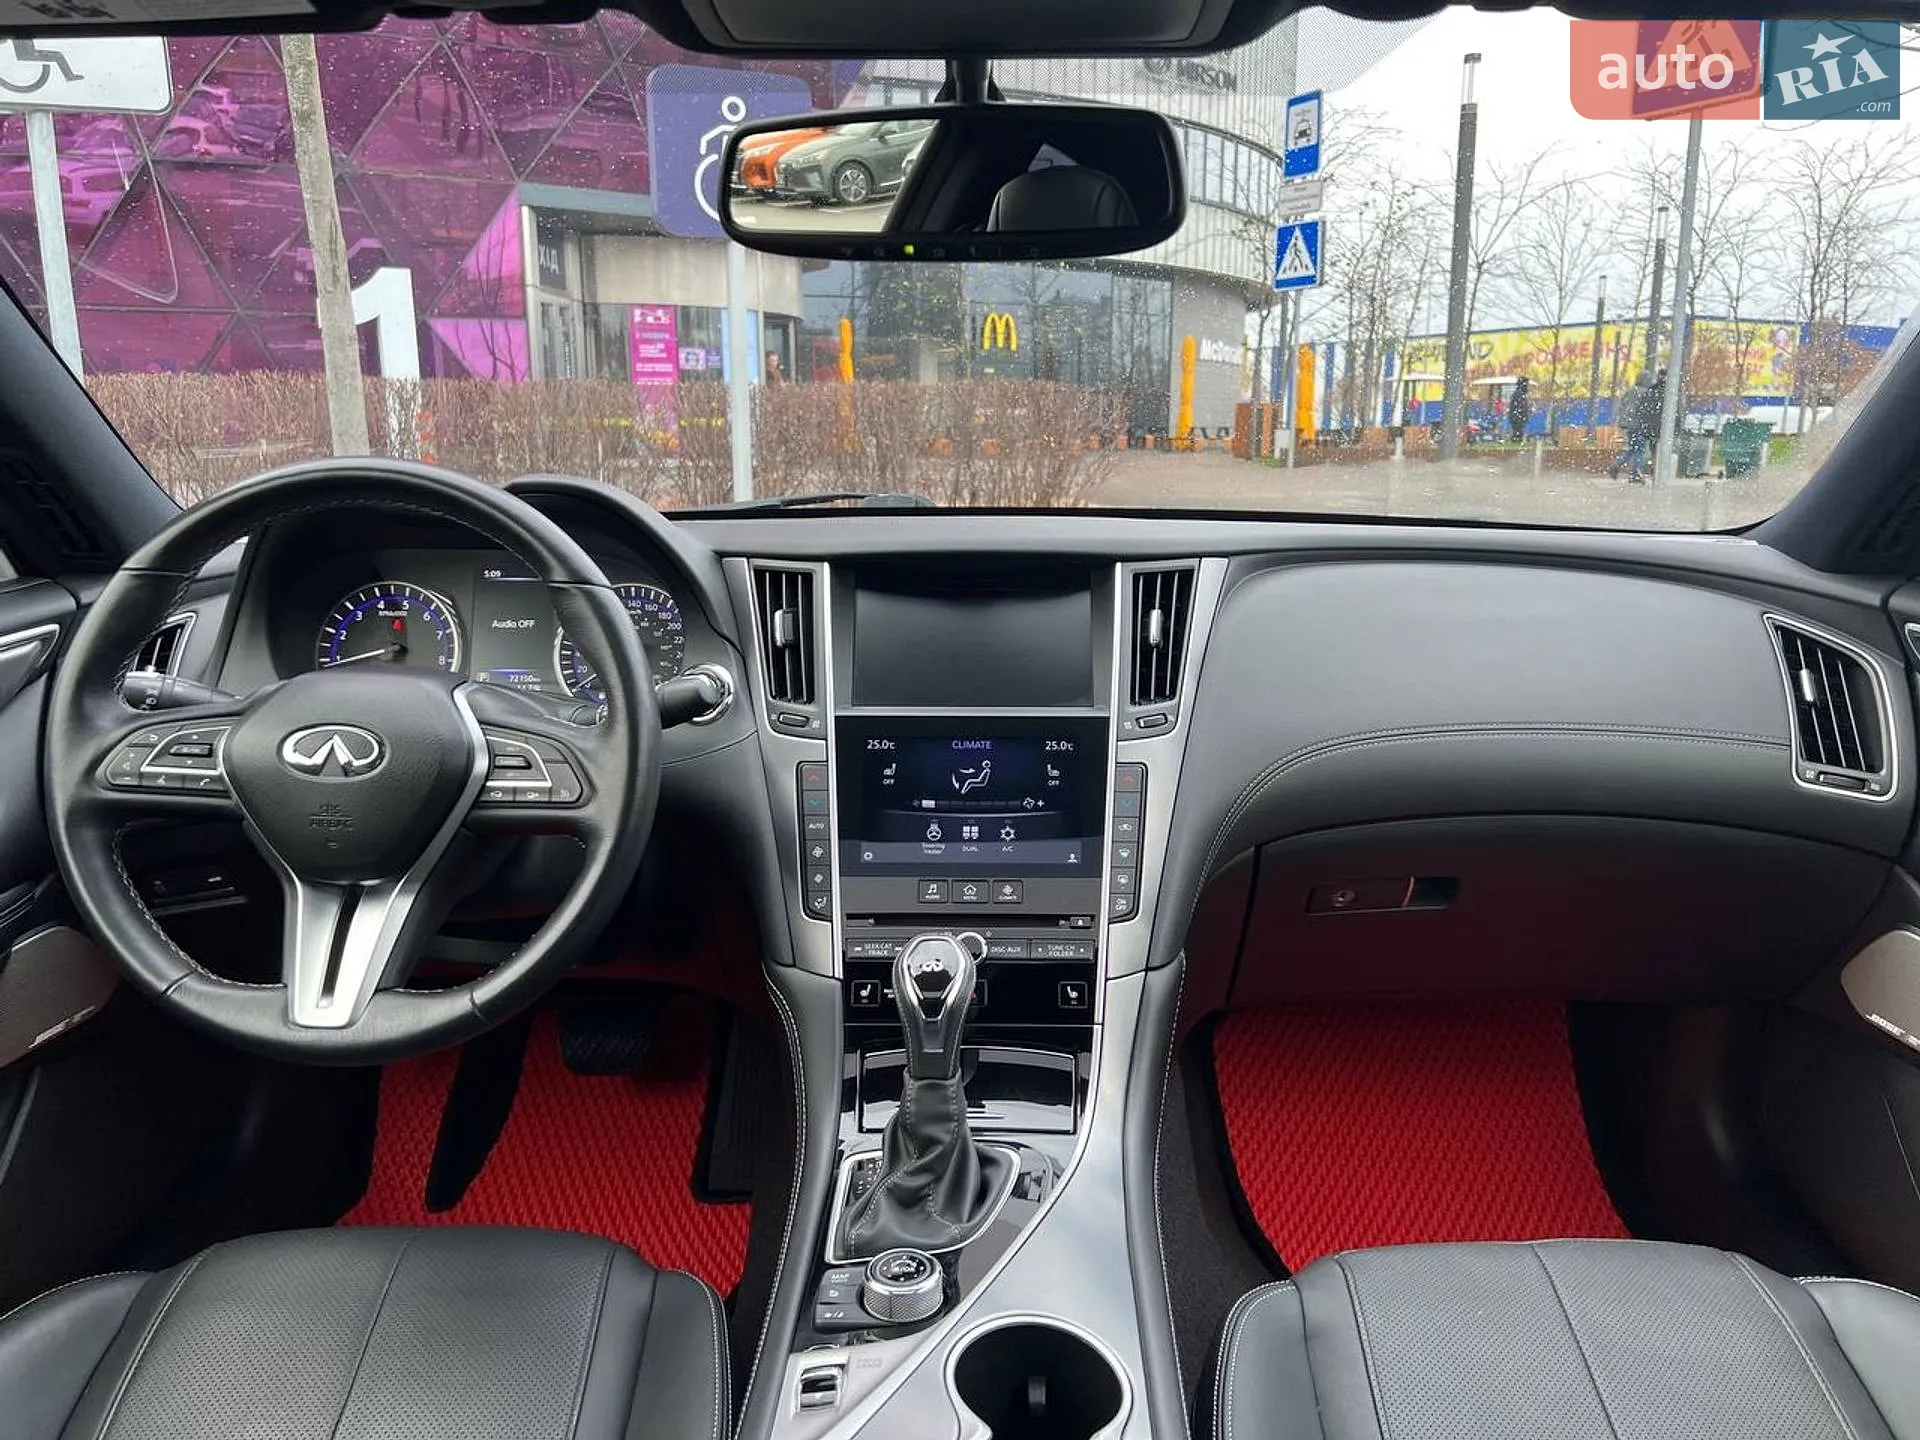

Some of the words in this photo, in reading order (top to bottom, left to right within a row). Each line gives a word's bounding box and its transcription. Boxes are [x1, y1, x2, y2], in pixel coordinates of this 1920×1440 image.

[377, 600, 385, 610] 4
[402, 600, 409, 610] 5
[356, 611, 363, 621] 3
[423, 612, 431, 621] 6
[492, 620, 517, 629] Audio
[518, 620, 536, 628] OFF
[340, 630, 347, 640] 2
[436, 631, 443, 640] 7
[439, 656, 446, 665] 8
[952, 740, 992, 749] CLIMATE
[808, 822, 825, 830] AUTO
